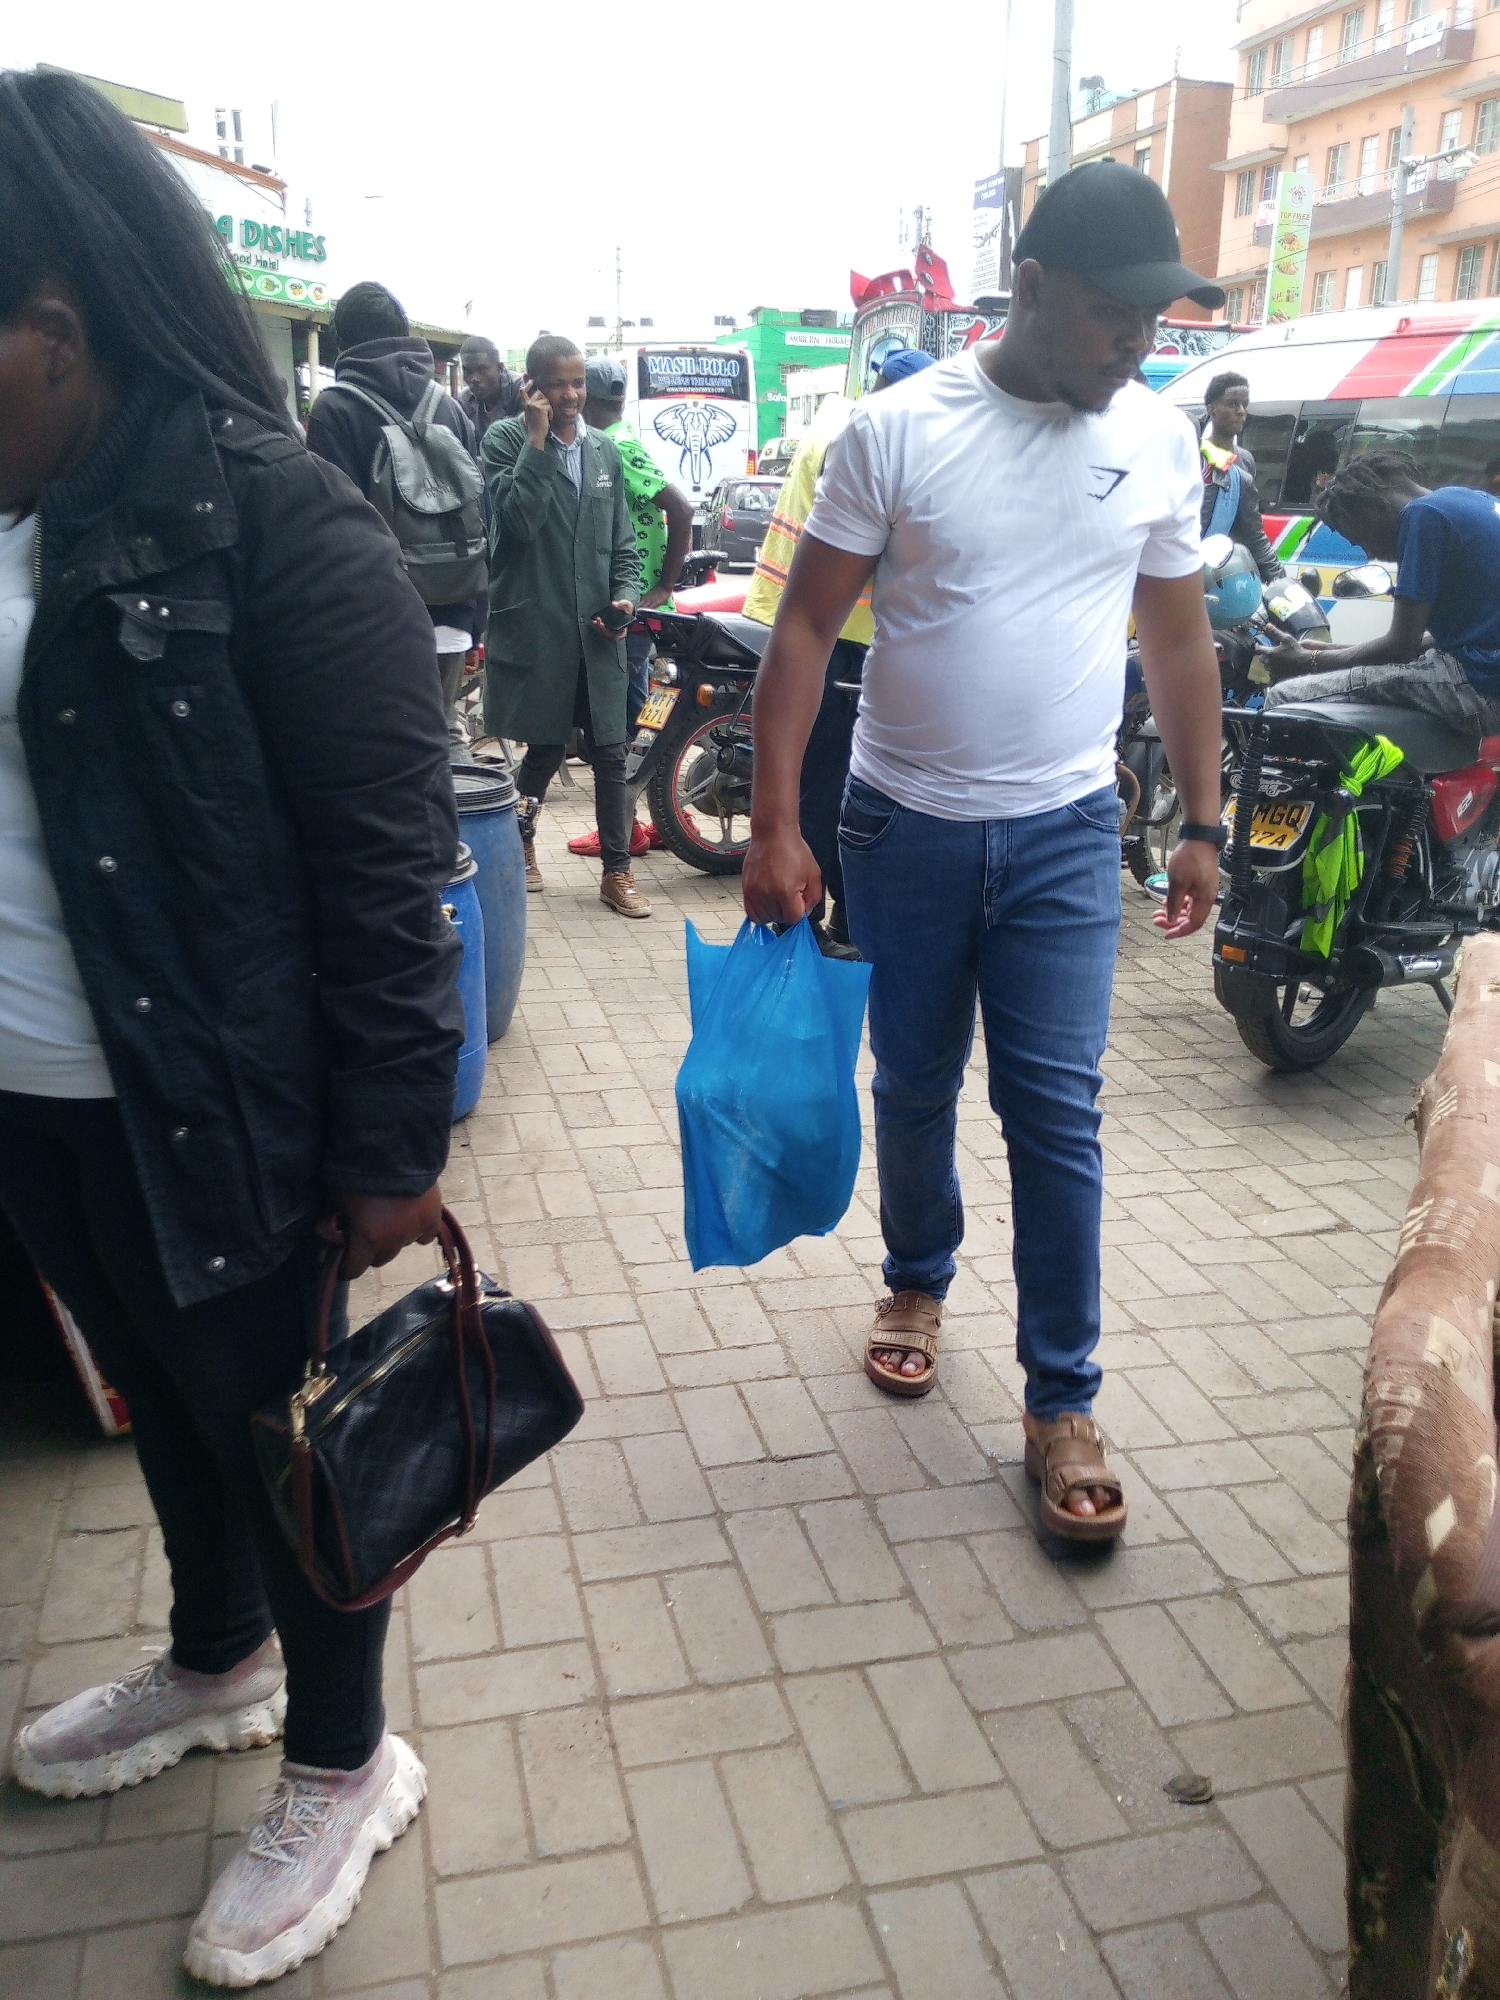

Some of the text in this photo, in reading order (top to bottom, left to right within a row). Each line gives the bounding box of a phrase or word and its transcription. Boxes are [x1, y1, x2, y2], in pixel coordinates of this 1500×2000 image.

[240, 219, 327, 262] DISHES
[233, 253, 252, 264] ood
[648, 356, 740, 377] MASH POLO
[1252, 803, 1306, 832] MGQ
[1249, 829, 1289, 847] 77A
